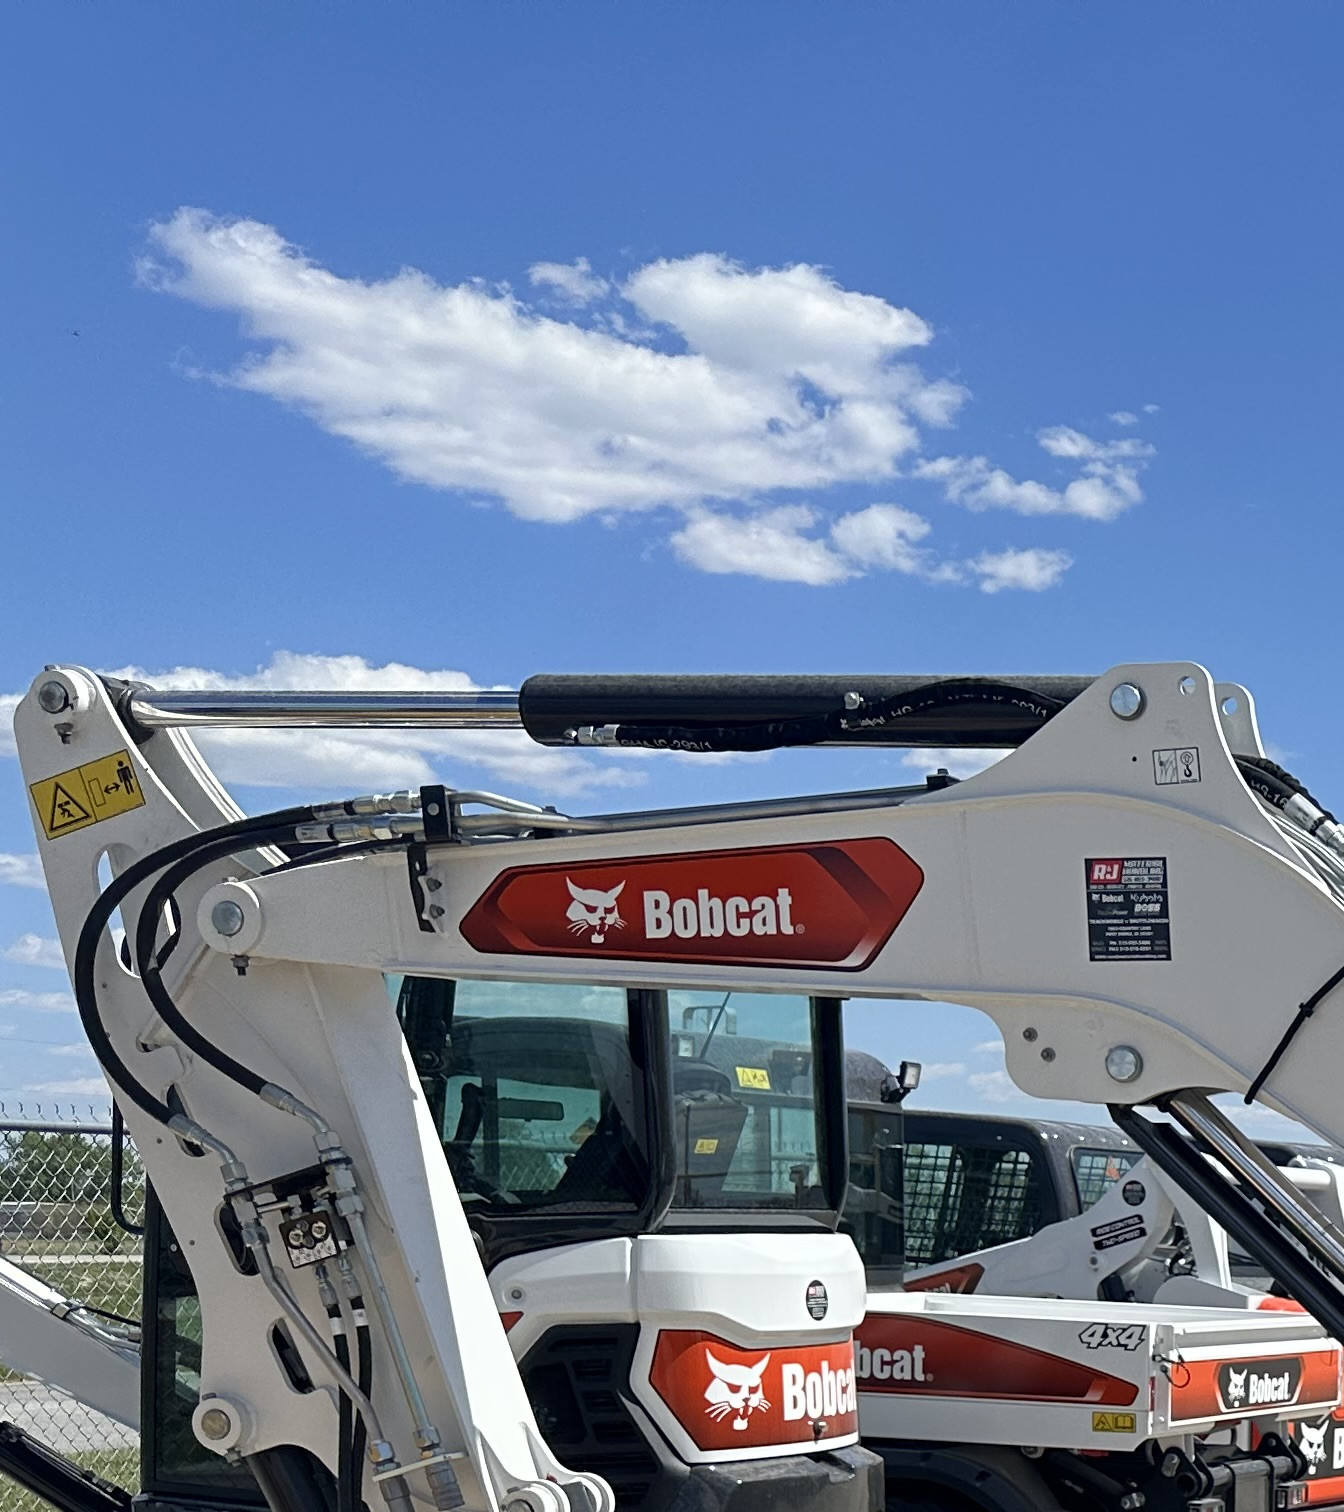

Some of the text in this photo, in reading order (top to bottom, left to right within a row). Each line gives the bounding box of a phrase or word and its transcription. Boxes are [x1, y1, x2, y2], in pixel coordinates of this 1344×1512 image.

[643, 888, 795, 939] Bobcat
[1079, 1323, 1149, 1351] 4x4
[1249, 1371, 1290, 1404] Bobcat
